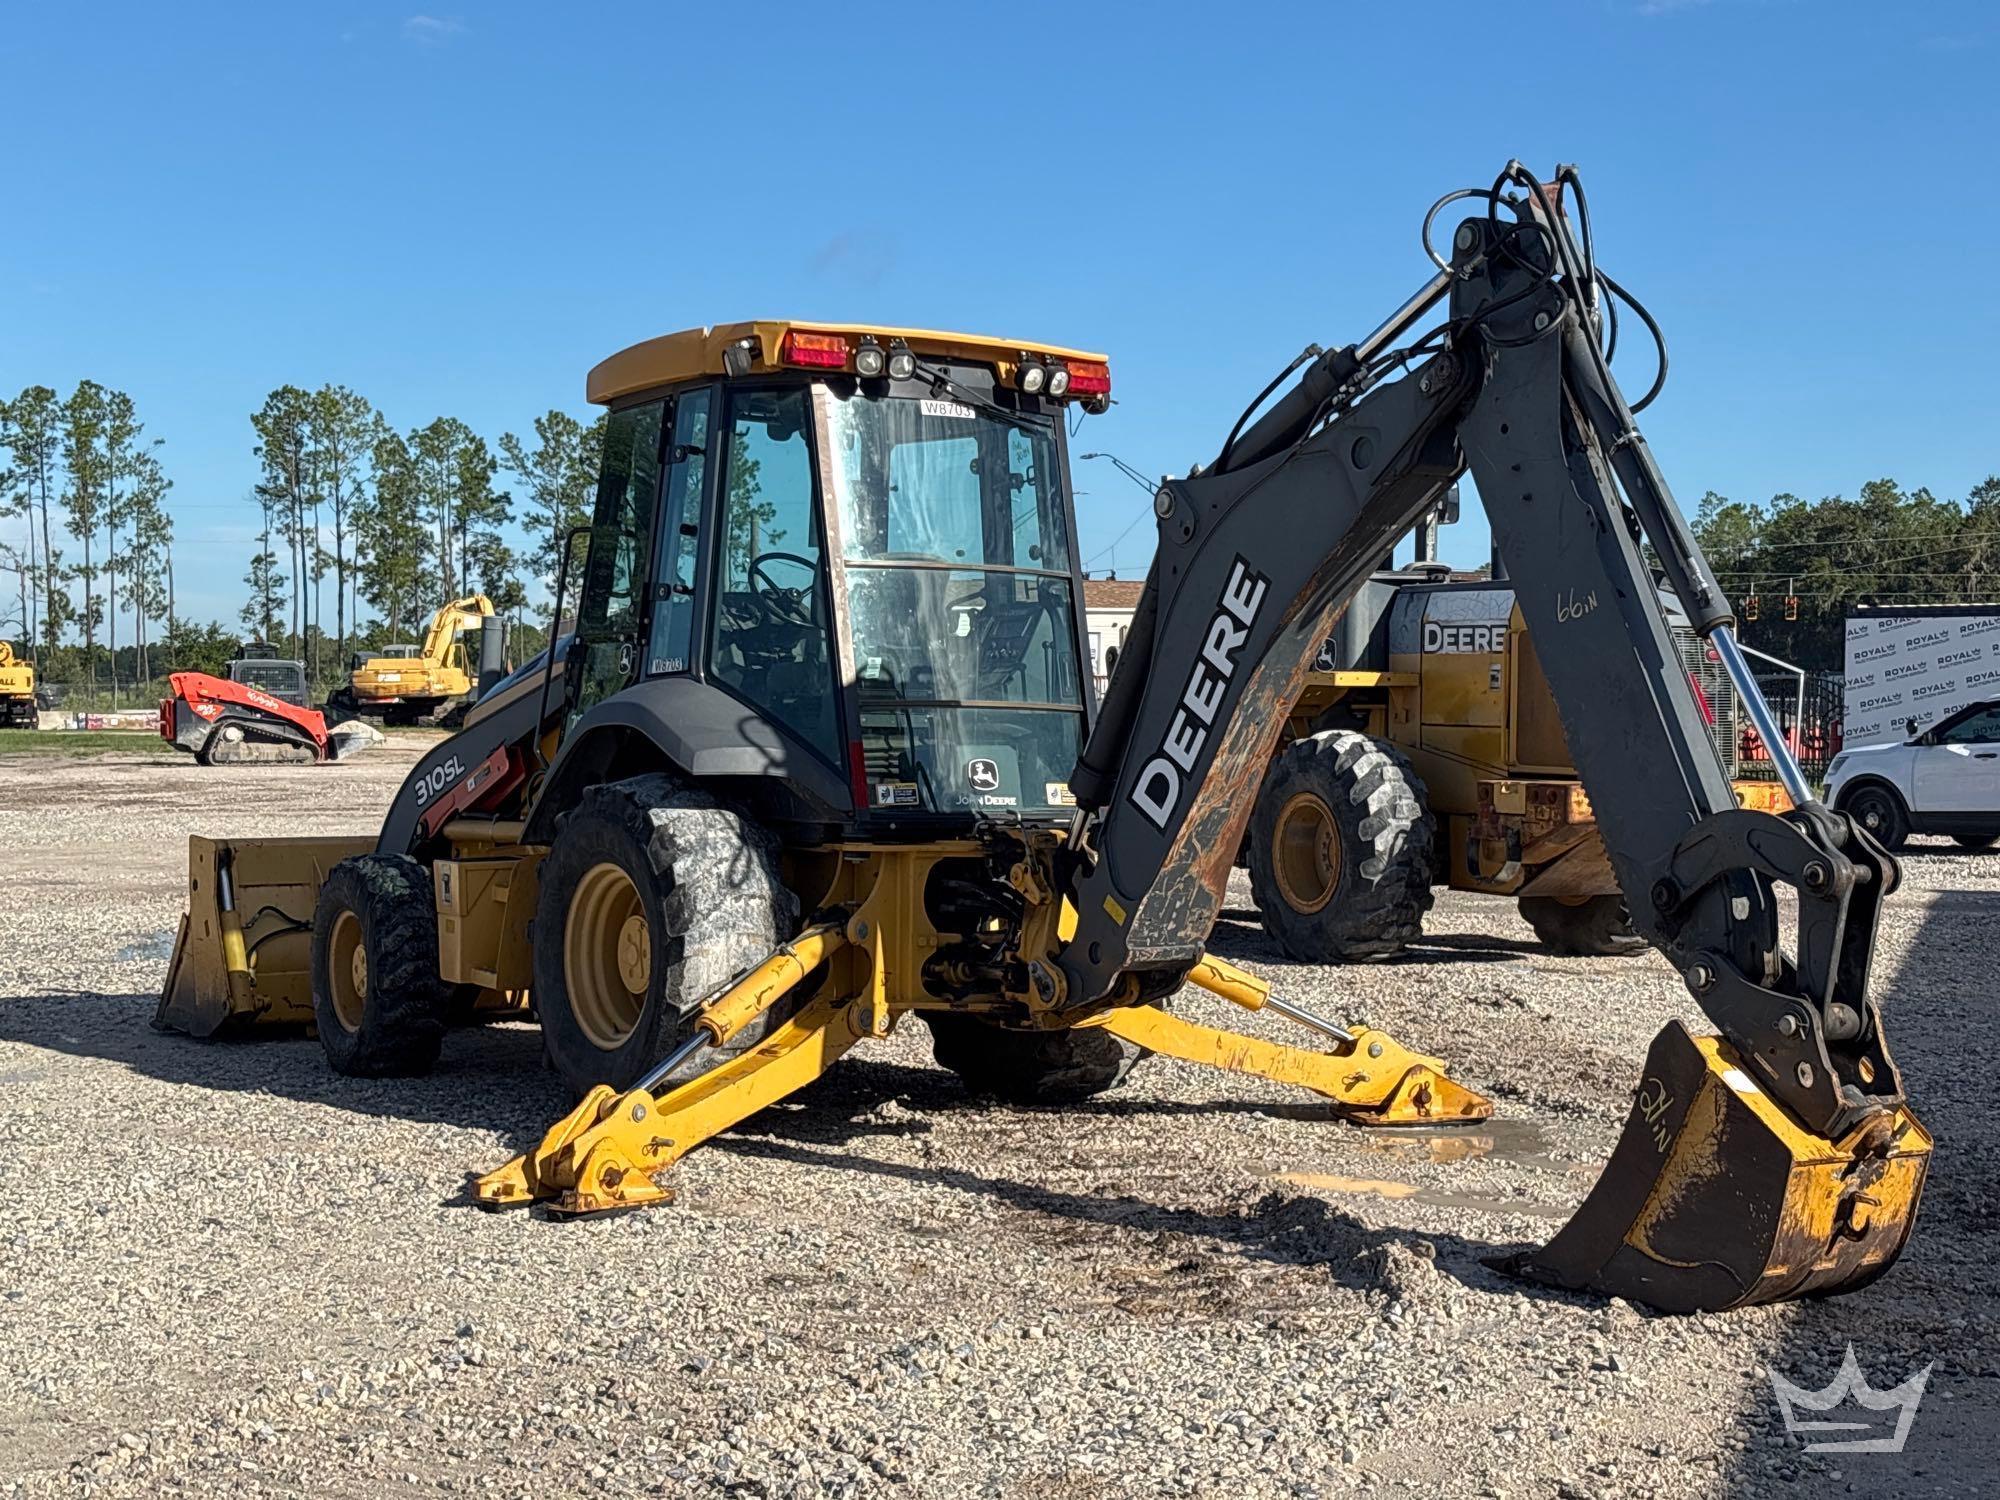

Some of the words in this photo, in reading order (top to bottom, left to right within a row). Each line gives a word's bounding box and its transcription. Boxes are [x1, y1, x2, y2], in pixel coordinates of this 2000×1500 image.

[925, 402, 971, 417] W8703
[1960, 619, 1994, 633] ROYAL
[1423, 623, 1506, 652] DEERE
[1906, 633, 1940, 647] ROYAL
[1854, 646, 1887, 660] ROYAL
[1937, 651, 1972, 664] ROYAL
[655, 658, 681, 671] W8703
[1885, 664, 1918, 677] ROYAL
[1845, 677, 1866, 686] YAL
[1966, 670, 2000, 684] ROYAL
[1132, 561, 1266, 828] DEERE
[1912, 683, 1946, 696] ROYAL
[1860, 695, 1893, 708] ROYAL
[1943, 704, 1970, 715] ROY
[1845, 725, 1872, 736] OYAL
[415, 755, 465, 806] 310SL
[984, 795, 1017, 806] DEERE
